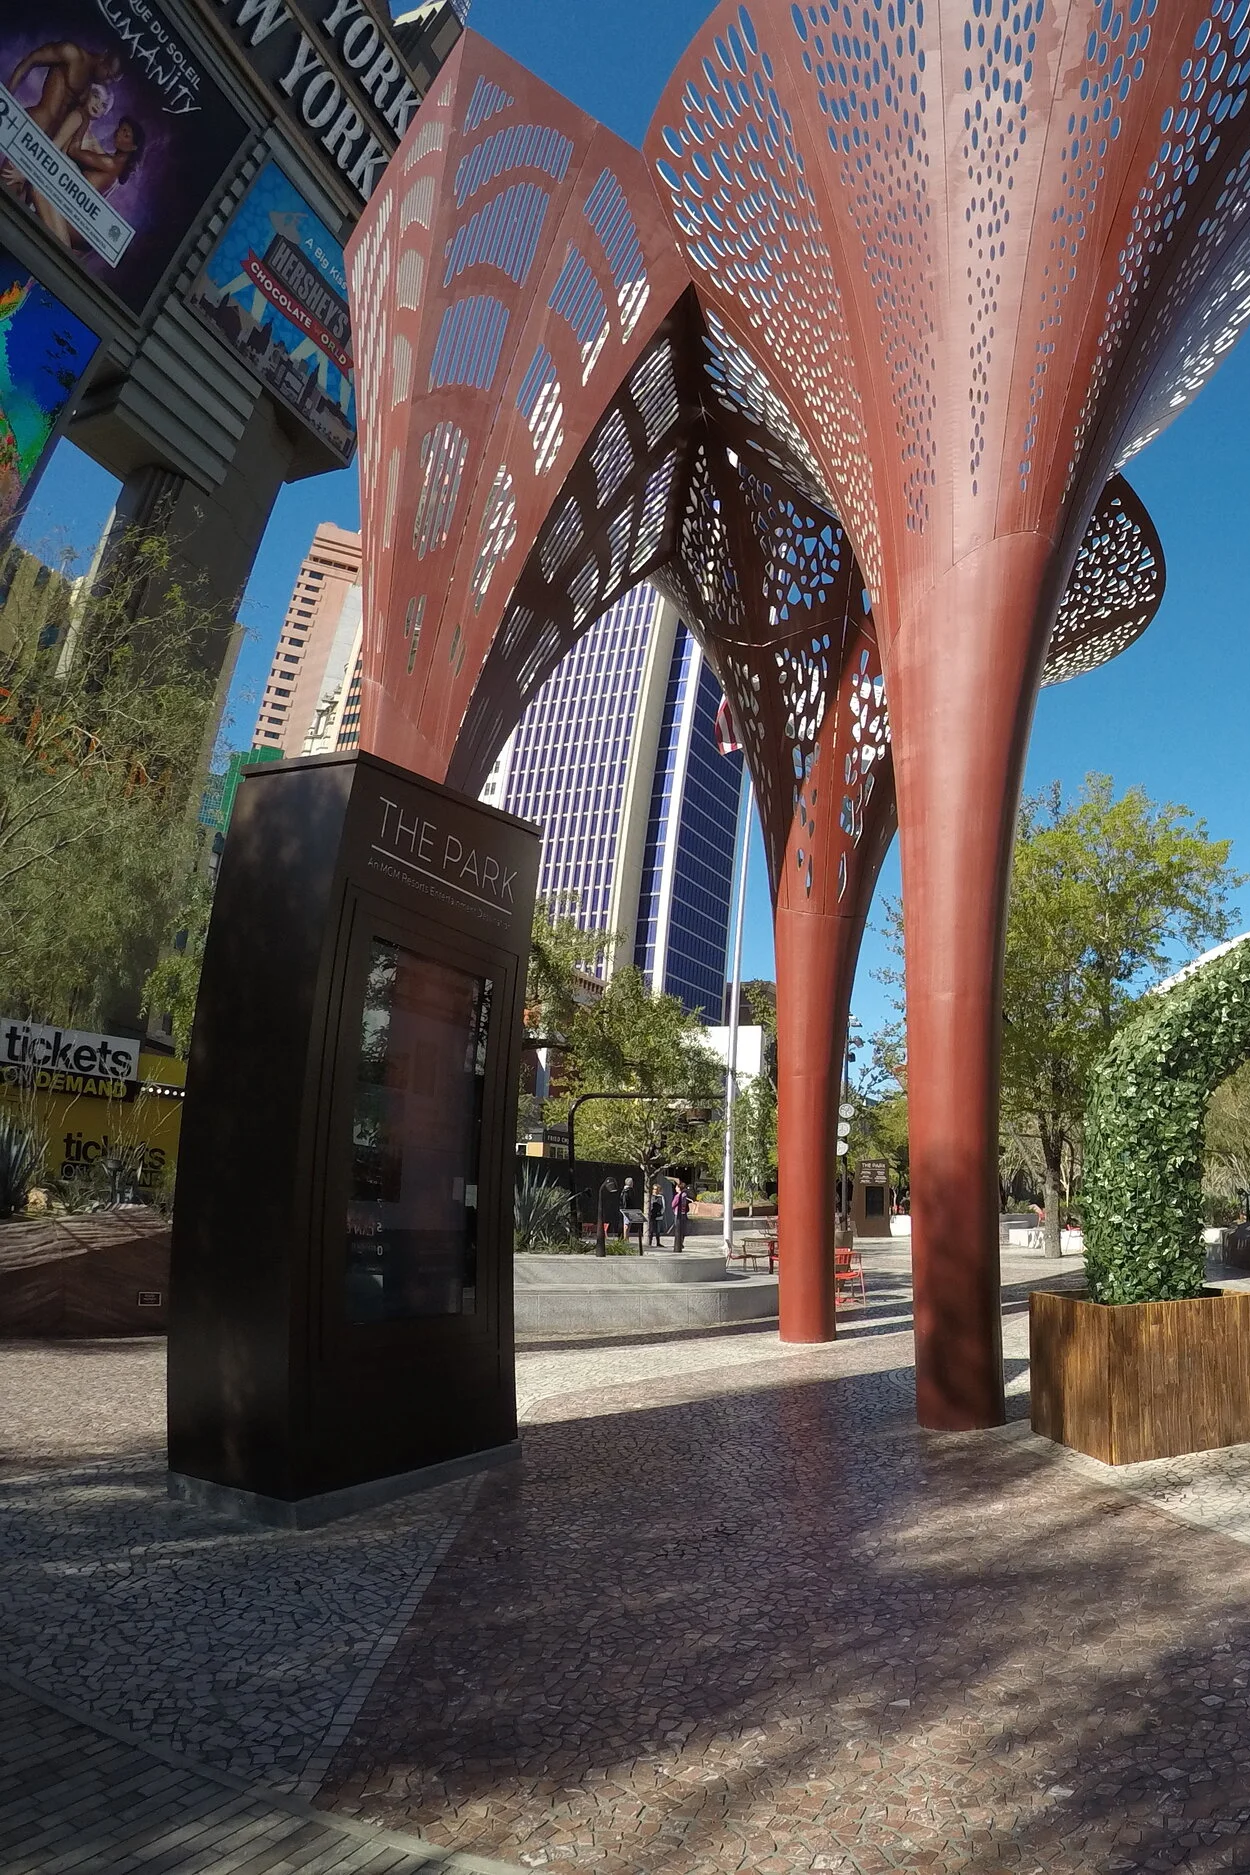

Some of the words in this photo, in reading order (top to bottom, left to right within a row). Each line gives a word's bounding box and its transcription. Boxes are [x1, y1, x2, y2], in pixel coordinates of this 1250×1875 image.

[150, 21, 169, 43] DU
[167, 43, 201, 90] SOLEIL
[322, 0, 422, 141] YORK
[278, 31, 390, 201] YORK
[21, 131, 59, 177] RATED
[58, 172, 101, 221] CIRQUE
[305, 238, 314, 249] A
[251, 262, 312, 329] CHOCOLATE
[271, 242, 348, 340] HERSHEY'S
[368, 857, 380, 869] An
[380, 862, 400, 880] MGM
[402, 872, 429, 894] Resorts
[380, 796, 437, 863] THE
[443, 835, 518, 904] PARK
[5, 1026, 132, 1078] tickets
[36, 1071, 127, 1098] DEMAND
